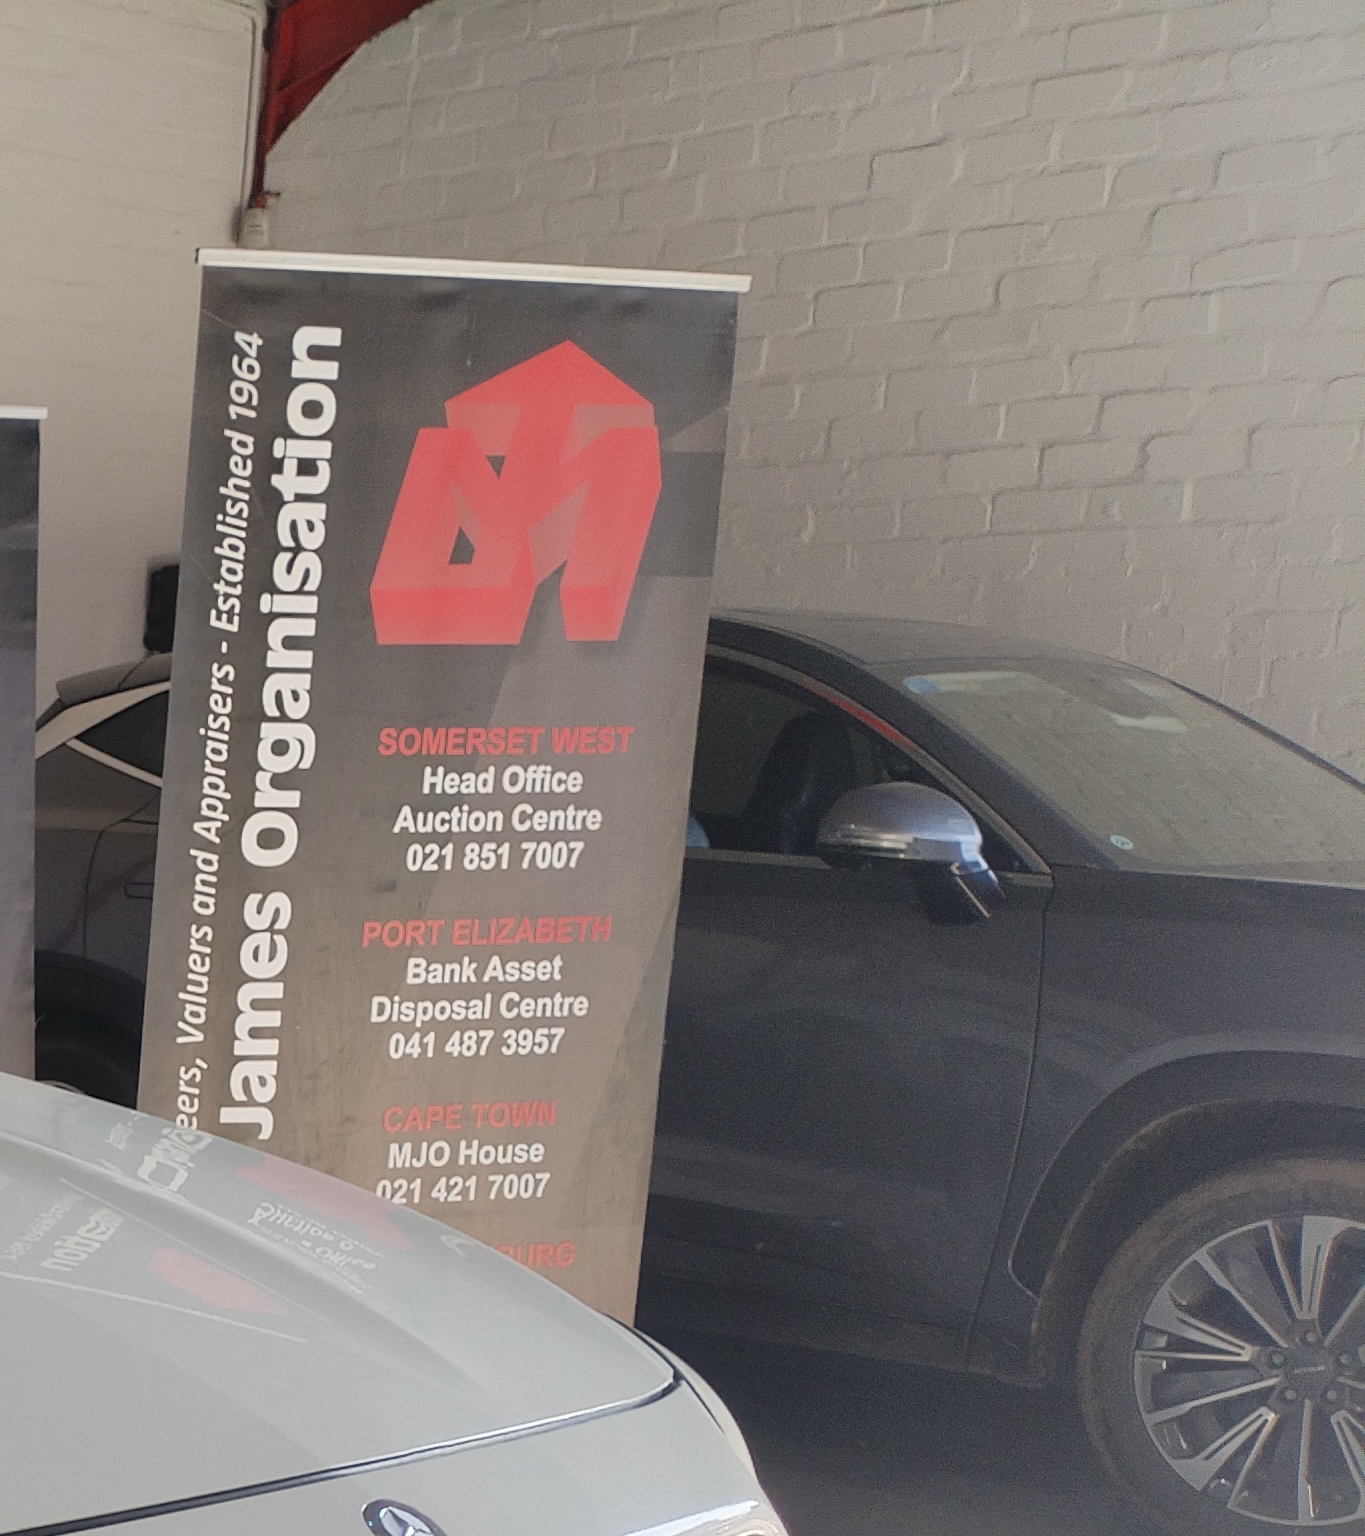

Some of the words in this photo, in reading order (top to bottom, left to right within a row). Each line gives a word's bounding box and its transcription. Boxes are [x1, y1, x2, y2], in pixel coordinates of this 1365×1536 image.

[228, 330, 265, 422] 1964
[209, 428, 254, 632] Established
[240, 324, 344, 867] Organisation
[192, 661, 236, 844] Appraisers
[376, 725, 547, 756] SOMERSET
[551, 724, 637, 754] WEST
[421, 764, 497, 795] Head
[501, 763, 584, 794] Office
[391, 803, 505, 834] Auction
[510, 802, 604, 832] Centre
[405, 841, 455, 872] 021
[462, 840, 511, 871] 851
[520, 840, 586, 870] 7007
[189, 848, 220, 917] and
[361, 918, 447, 949] PORT
[451, 914, 613, 947] ELIZABETH
[175, 923, 214, 1044] Valuers
[405, 955, 478, 985] Bank
[482, 953, 565, 983] Asset
[219, 890, 293, 1141] James
[369, 991, 493, 1028] Disposal
[498, 990, 591, 1020] Centre
[388, 1030, 437, 1060] 041
[444, 1029, 495, 1058] 487
[501, 1027, 567, 1056] 3957
[382, 1103, 465, 1133] CAPE
[470, 1099, 559, 1130] TOWN
[387, 1139, 451, 1169] MJO
[457, 1138, 546, 1166] House
[375, 1176, 422, 1204] 021
[430, 1174, 478, 1203] 421
[487, 1171, 552, 1200] 7007
